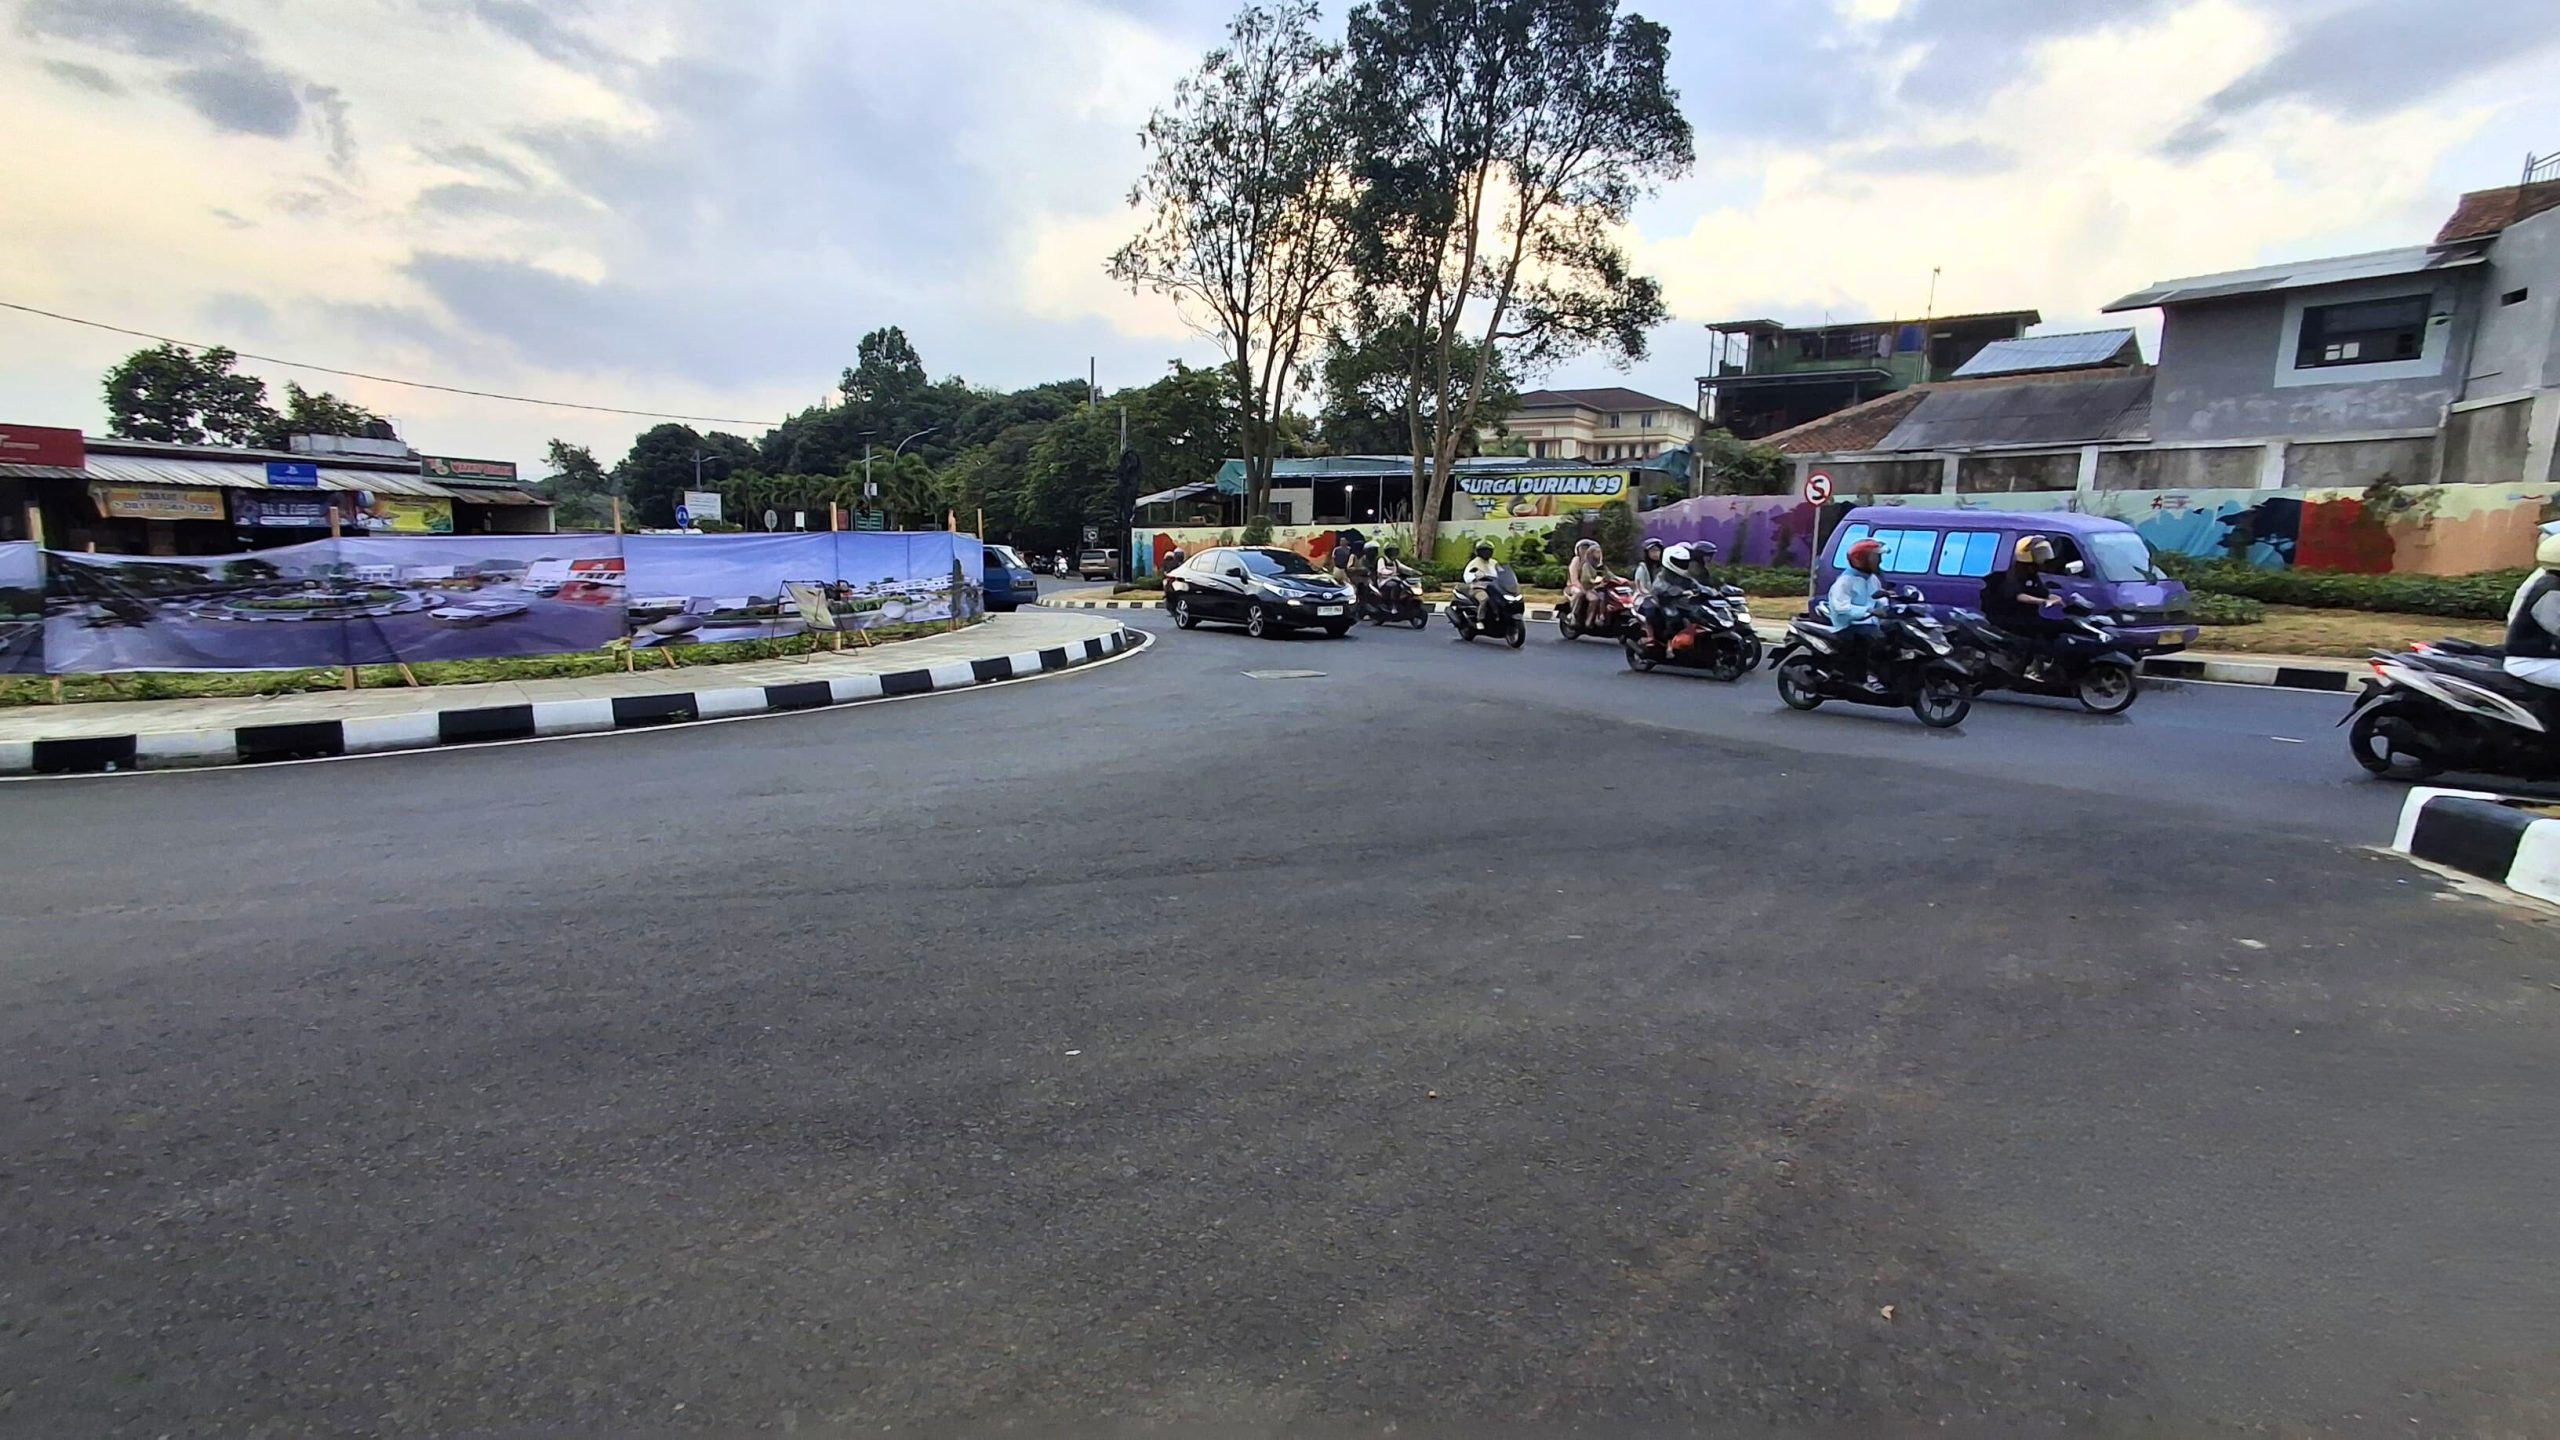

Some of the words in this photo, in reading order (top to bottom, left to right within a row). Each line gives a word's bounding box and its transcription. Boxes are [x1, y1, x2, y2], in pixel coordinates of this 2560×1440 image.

[1460, 477, 1518, 494] SURGA
[1519, 476, 1593, 493] DURIAN
[1593, 476, 1622, 493] 99
[1811, 479, 1825, 500] S
